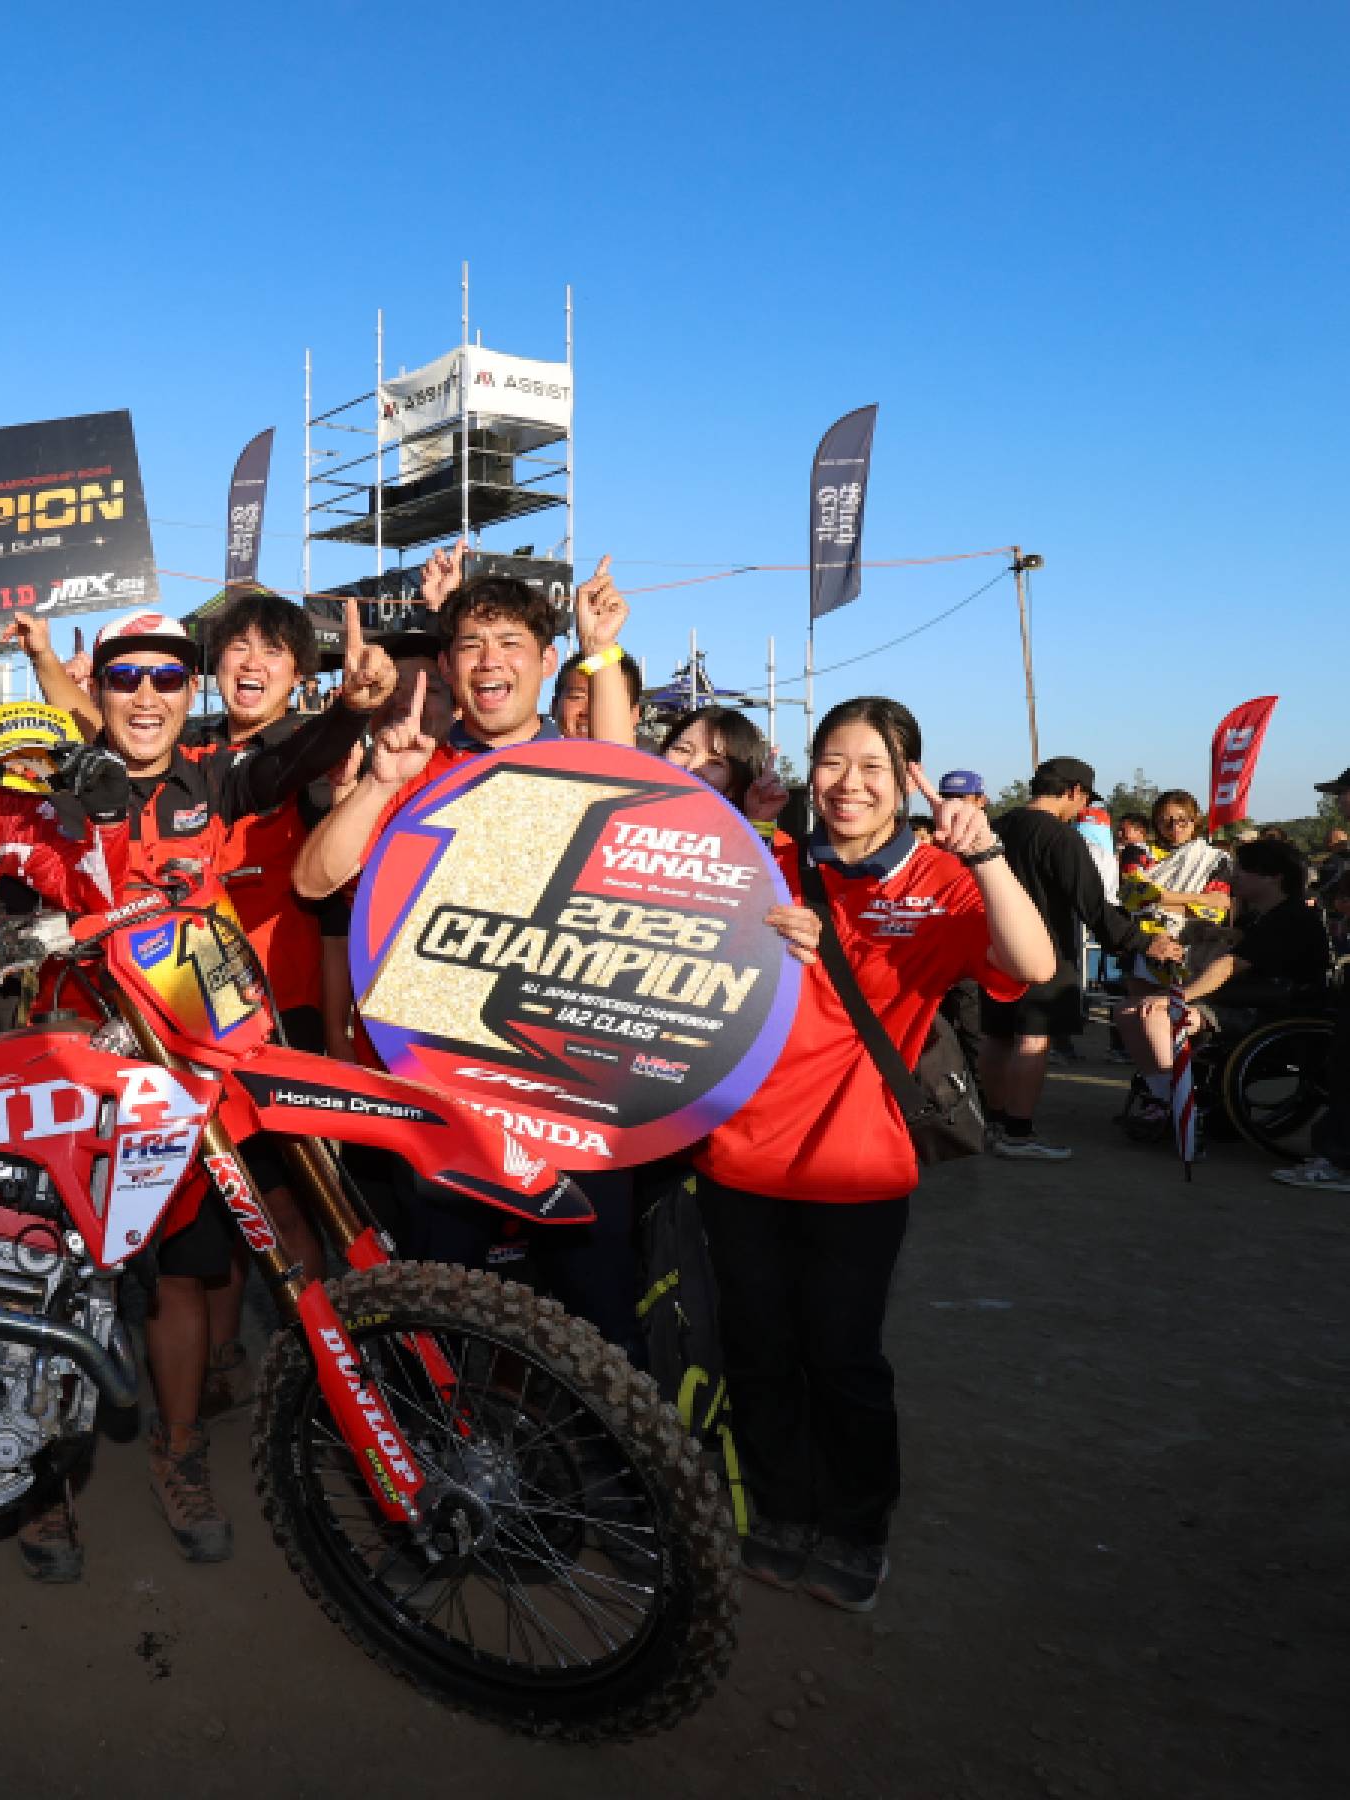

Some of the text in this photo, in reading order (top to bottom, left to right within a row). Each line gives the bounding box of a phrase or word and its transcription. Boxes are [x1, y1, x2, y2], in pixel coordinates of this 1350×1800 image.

[614, 821, 722, 859] TAIGA
[602, 846, 760, 891] YANASE
[556, 896, 728, 952] 2026
[420, 910, 762, 1014] CHAMPION
[555, 1005, 660, 1041] IA2 CLASS
[275, 1089, 425, 1120] Honda Dream
[122, 1130, 191, 1160] HRC
[317, 1327, 418, 1483] DUNLOP
